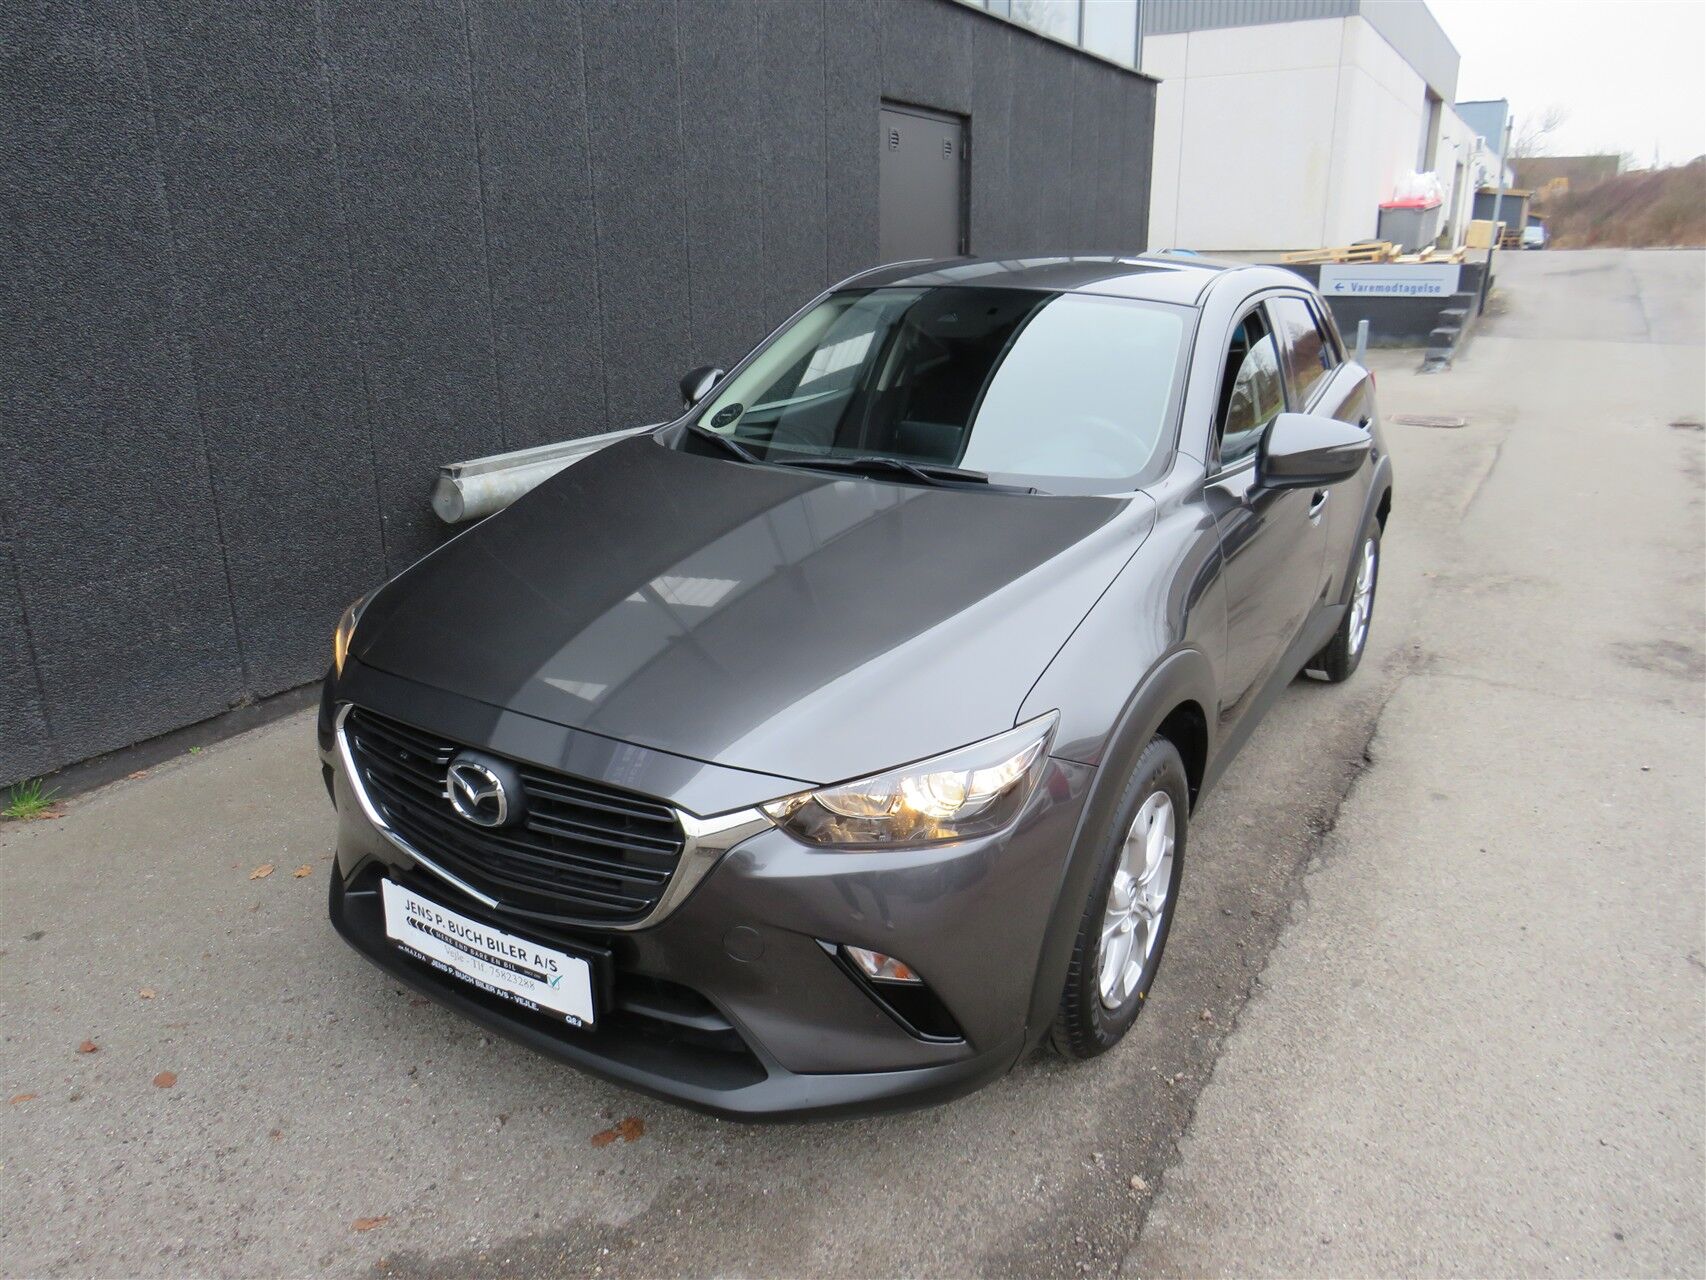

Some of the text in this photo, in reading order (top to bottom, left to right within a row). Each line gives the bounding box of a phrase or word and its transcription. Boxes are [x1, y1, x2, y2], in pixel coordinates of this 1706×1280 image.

[1351, 282, 1441, 295] Varemodtagelse
[405, 900, 558, 972] JENS P. BUCH BILER A/S
[444, 944, 464, 962] Vejle
[490, 956, 501, 966] EN
[504, 962, 516, 971] BIL
[431, 959, 448, 972] JENS
[455, 971, 474, 984] BUCH
[475, 979, 496, 993] BILER
